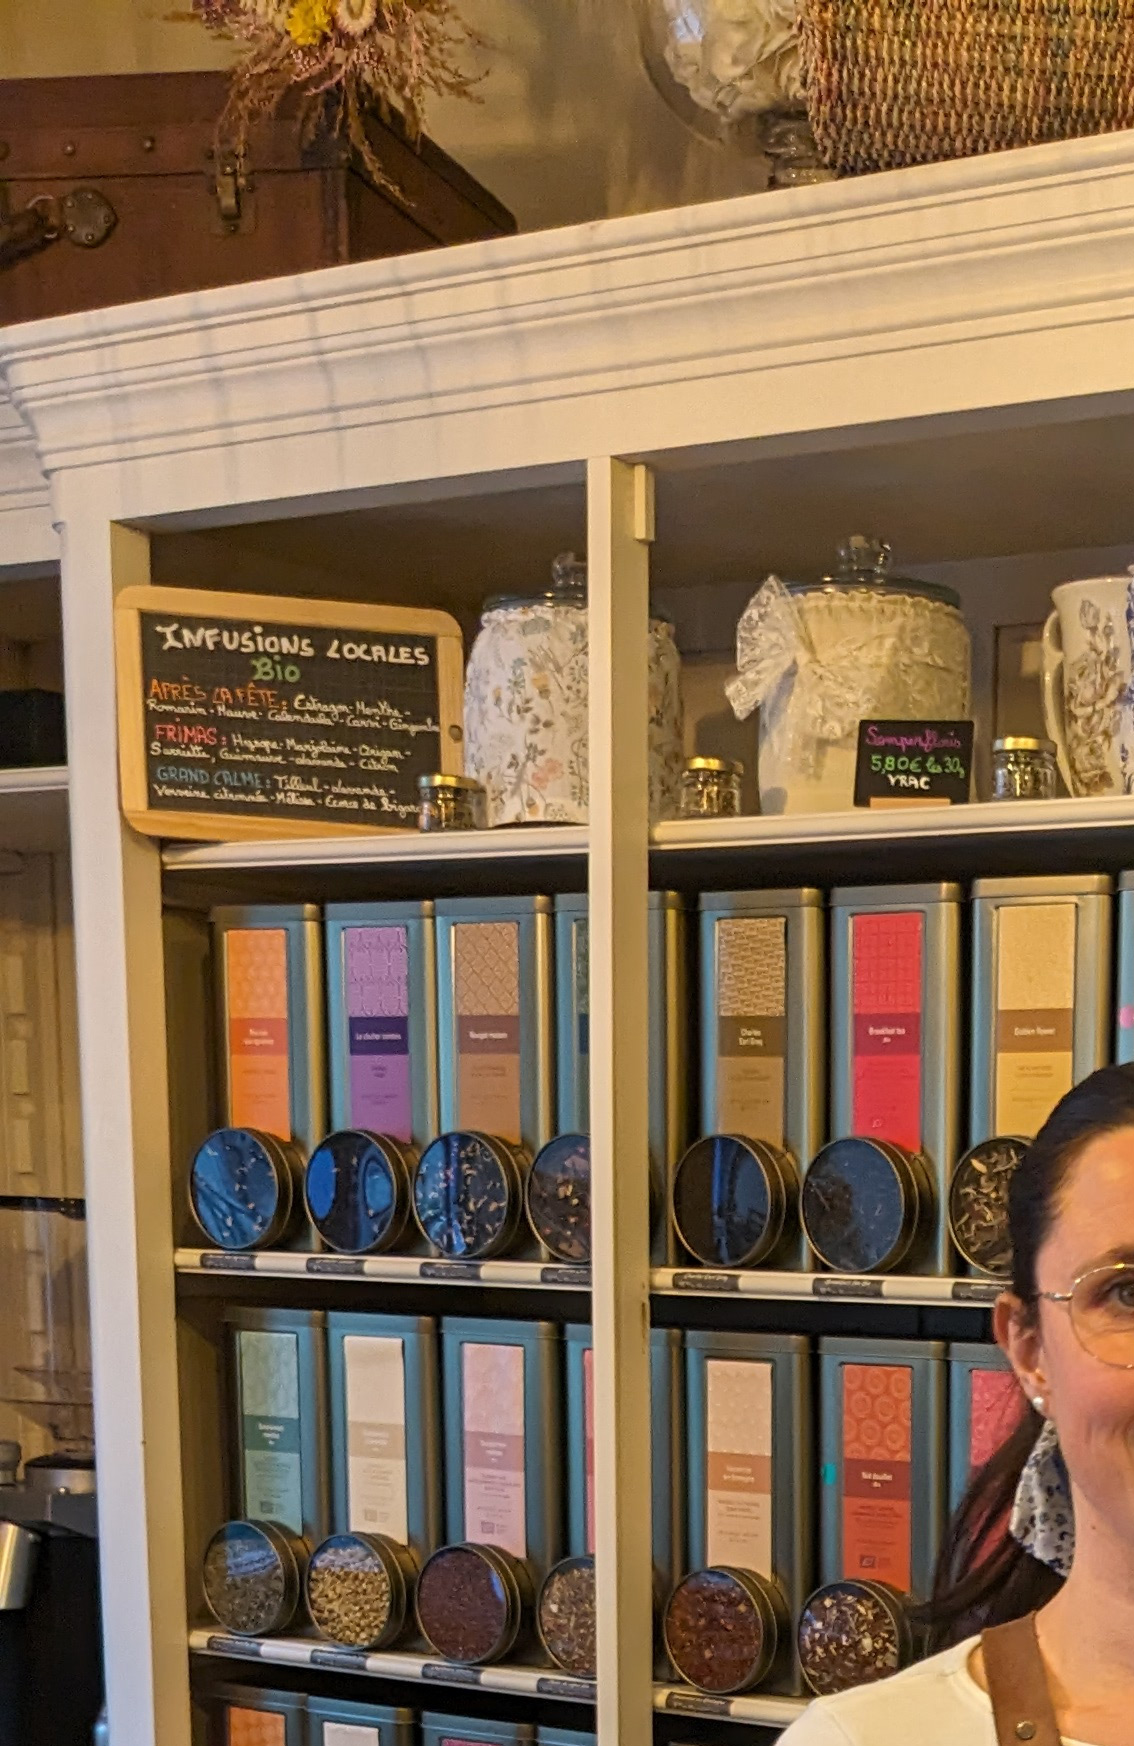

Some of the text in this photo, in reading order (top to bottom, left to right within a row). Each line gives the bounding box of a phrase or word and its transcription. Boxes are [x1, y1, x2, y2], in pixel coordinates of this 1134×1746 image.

[326, 639, 430, 666] LOCALES
[156, 766, 210, 785] GRAND
[888, 774, 931, 790] VRAC
